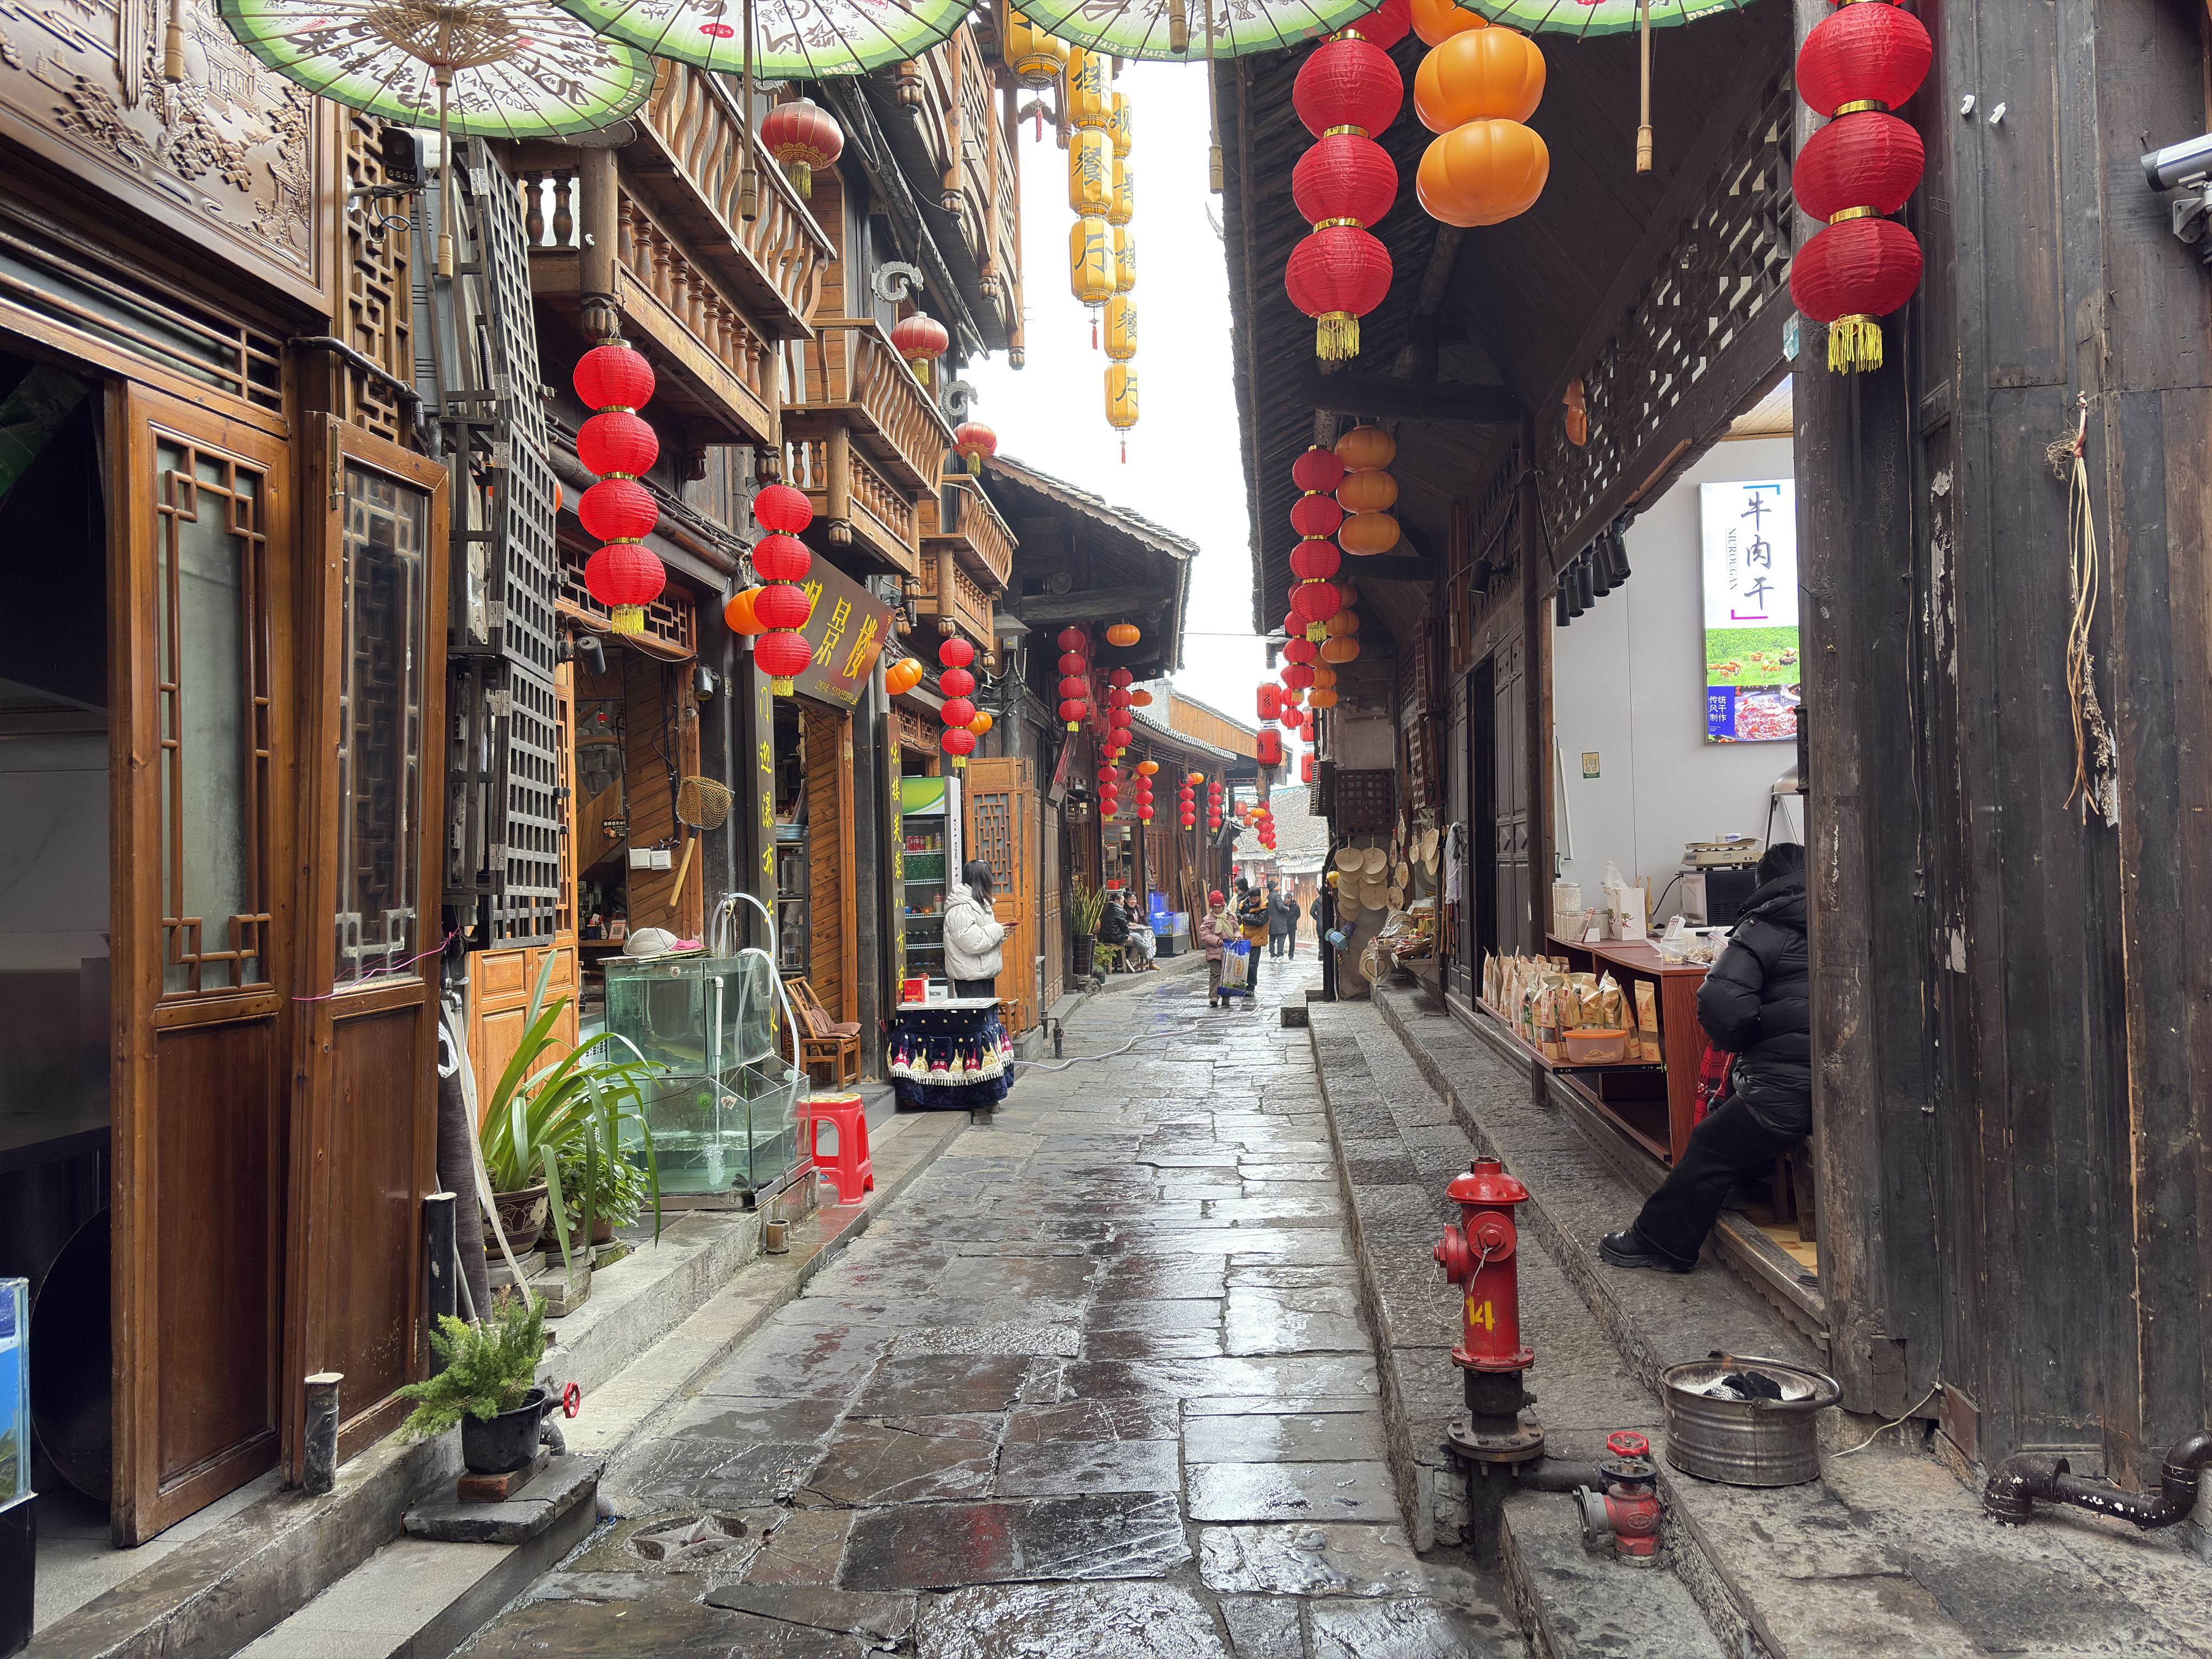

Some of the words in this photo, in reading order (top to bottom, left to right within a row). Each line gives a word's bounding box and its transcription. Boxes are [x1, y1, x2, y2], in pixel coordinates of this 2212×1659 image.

[1728, 528, 1737, 591] NIUROUGAN
[1741, 491, 1774, 611] 牛肉干
[1709, 695, 1727, 704] 传统
[1709, 704, 1727, 713] 风干
[1709, 713, 1727, 722] 制作
[1465, 1296, 1495, 1331] 14
